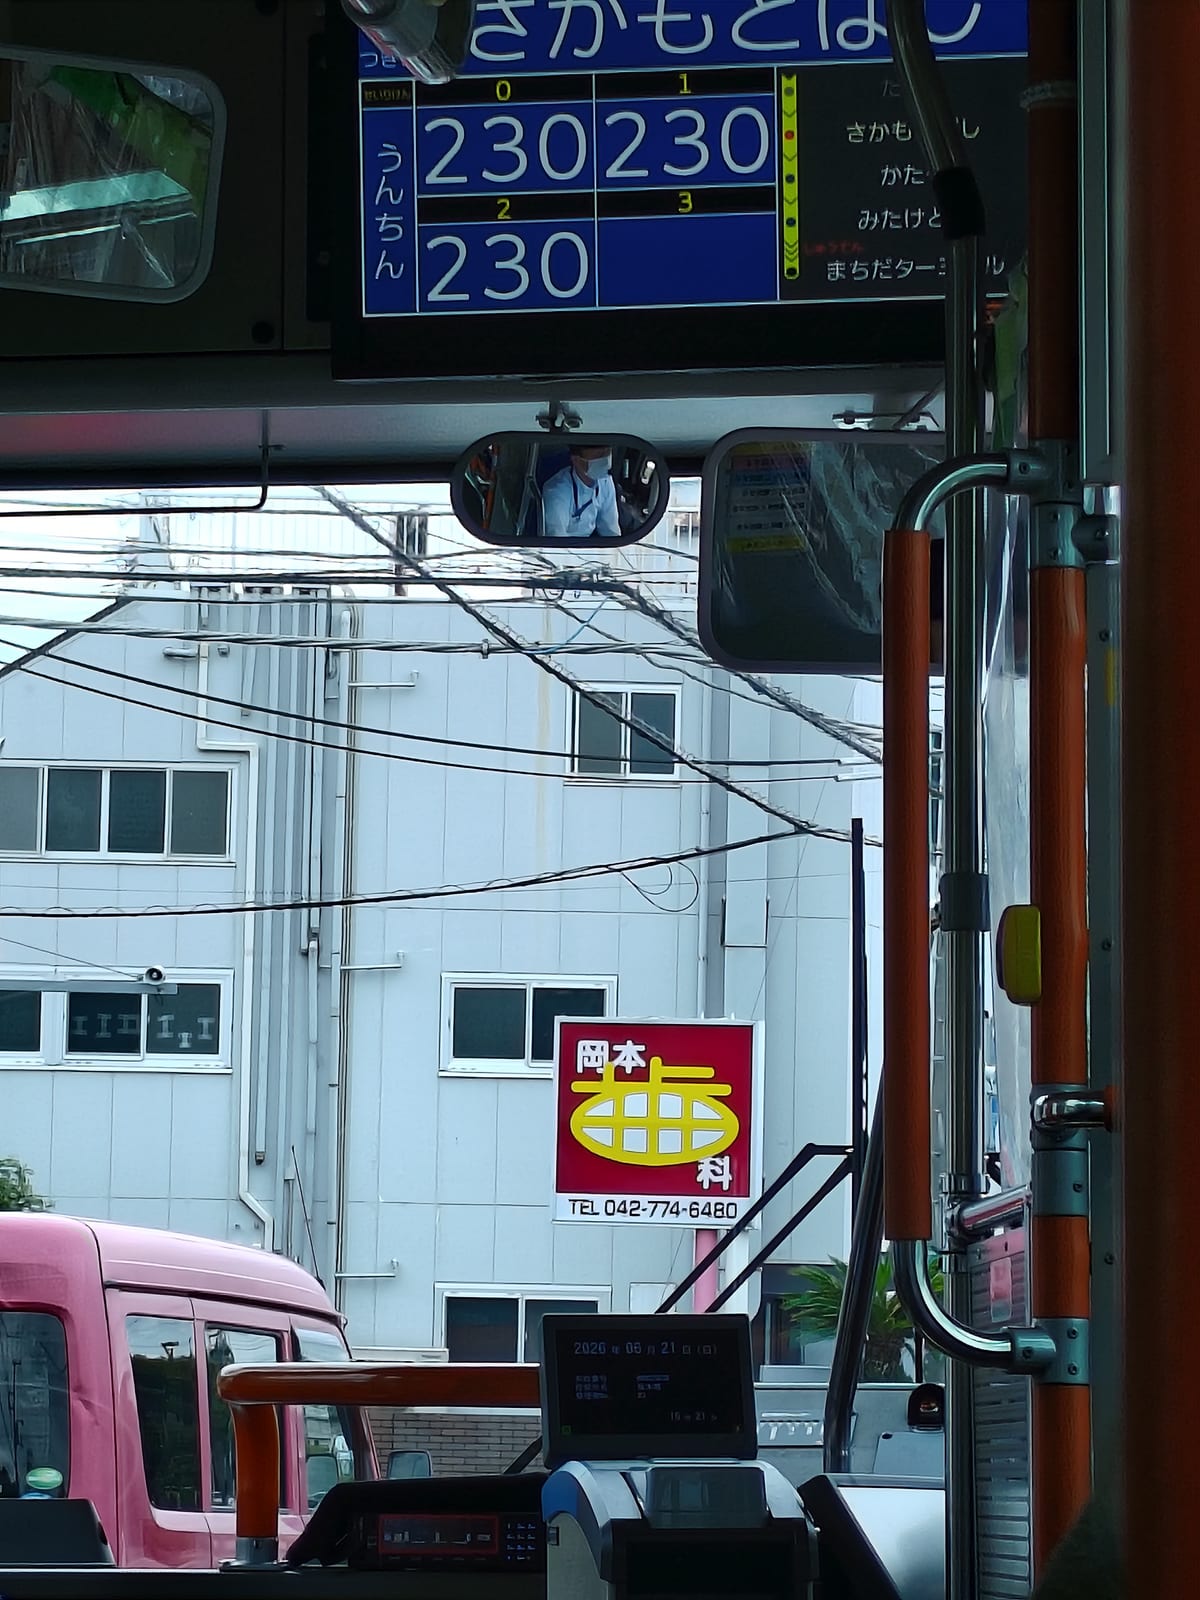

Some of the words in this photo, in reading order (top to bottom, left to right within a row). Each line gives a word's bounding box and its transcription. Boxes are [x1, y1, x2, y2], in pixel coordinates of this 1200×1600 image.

[495, 80, 511, 101] 0
[679, 73, 692, 94] 1
[605, 106, 770, 178] 230
[846, 117, 980, 143] さかもし
[424, 113, 588, 185] 230
[374, 143, 404, 280] うんちん
[497, 198, 512, 220] 2
[678, 191, 693, 213] 3
[426, 231, 589, 302] 230
[826, 256, 1006, 282] まちだターミル
[576, 1039, 646, 1074] 岡本
[696, 1156, 733, 1191] 科
[569, 1199, 599, 1215] TEL
[604, 1200, 738, 1219] 042-774-6480
